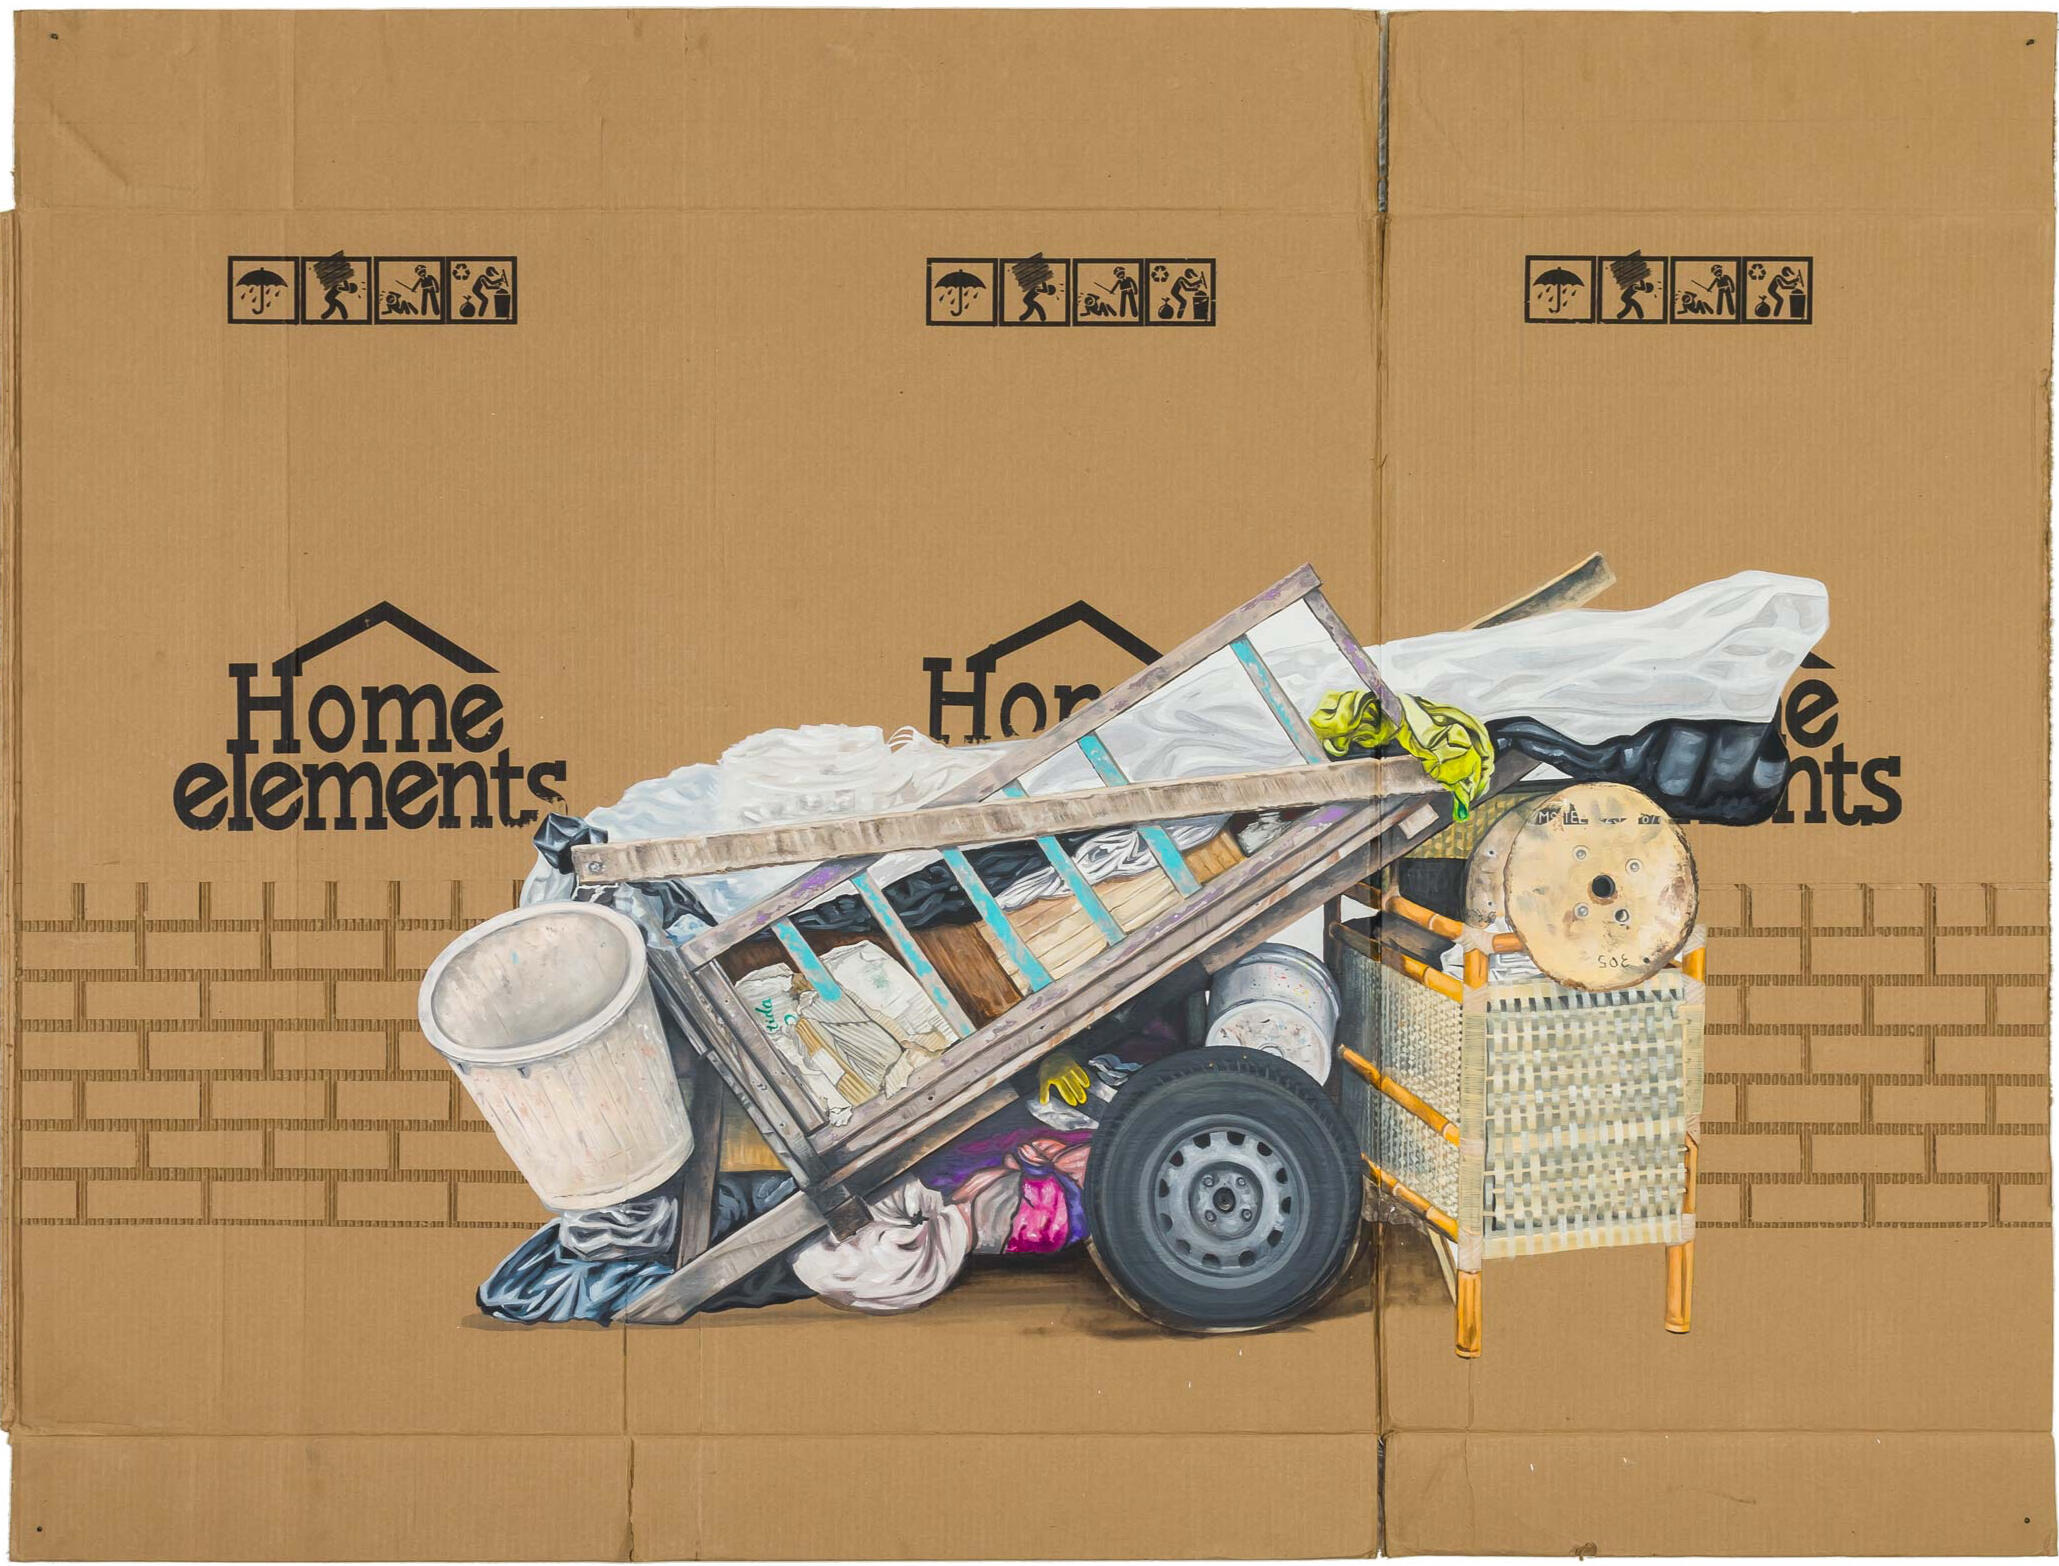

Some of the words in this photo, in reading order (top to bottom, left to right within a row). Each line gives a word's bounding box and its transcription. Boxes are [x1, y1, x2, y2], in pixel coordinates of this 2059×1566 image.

[227, 660, 503, 754] Home
[923, 656, 1102, 744] Ho
[173, 746, 568, 832] elements
